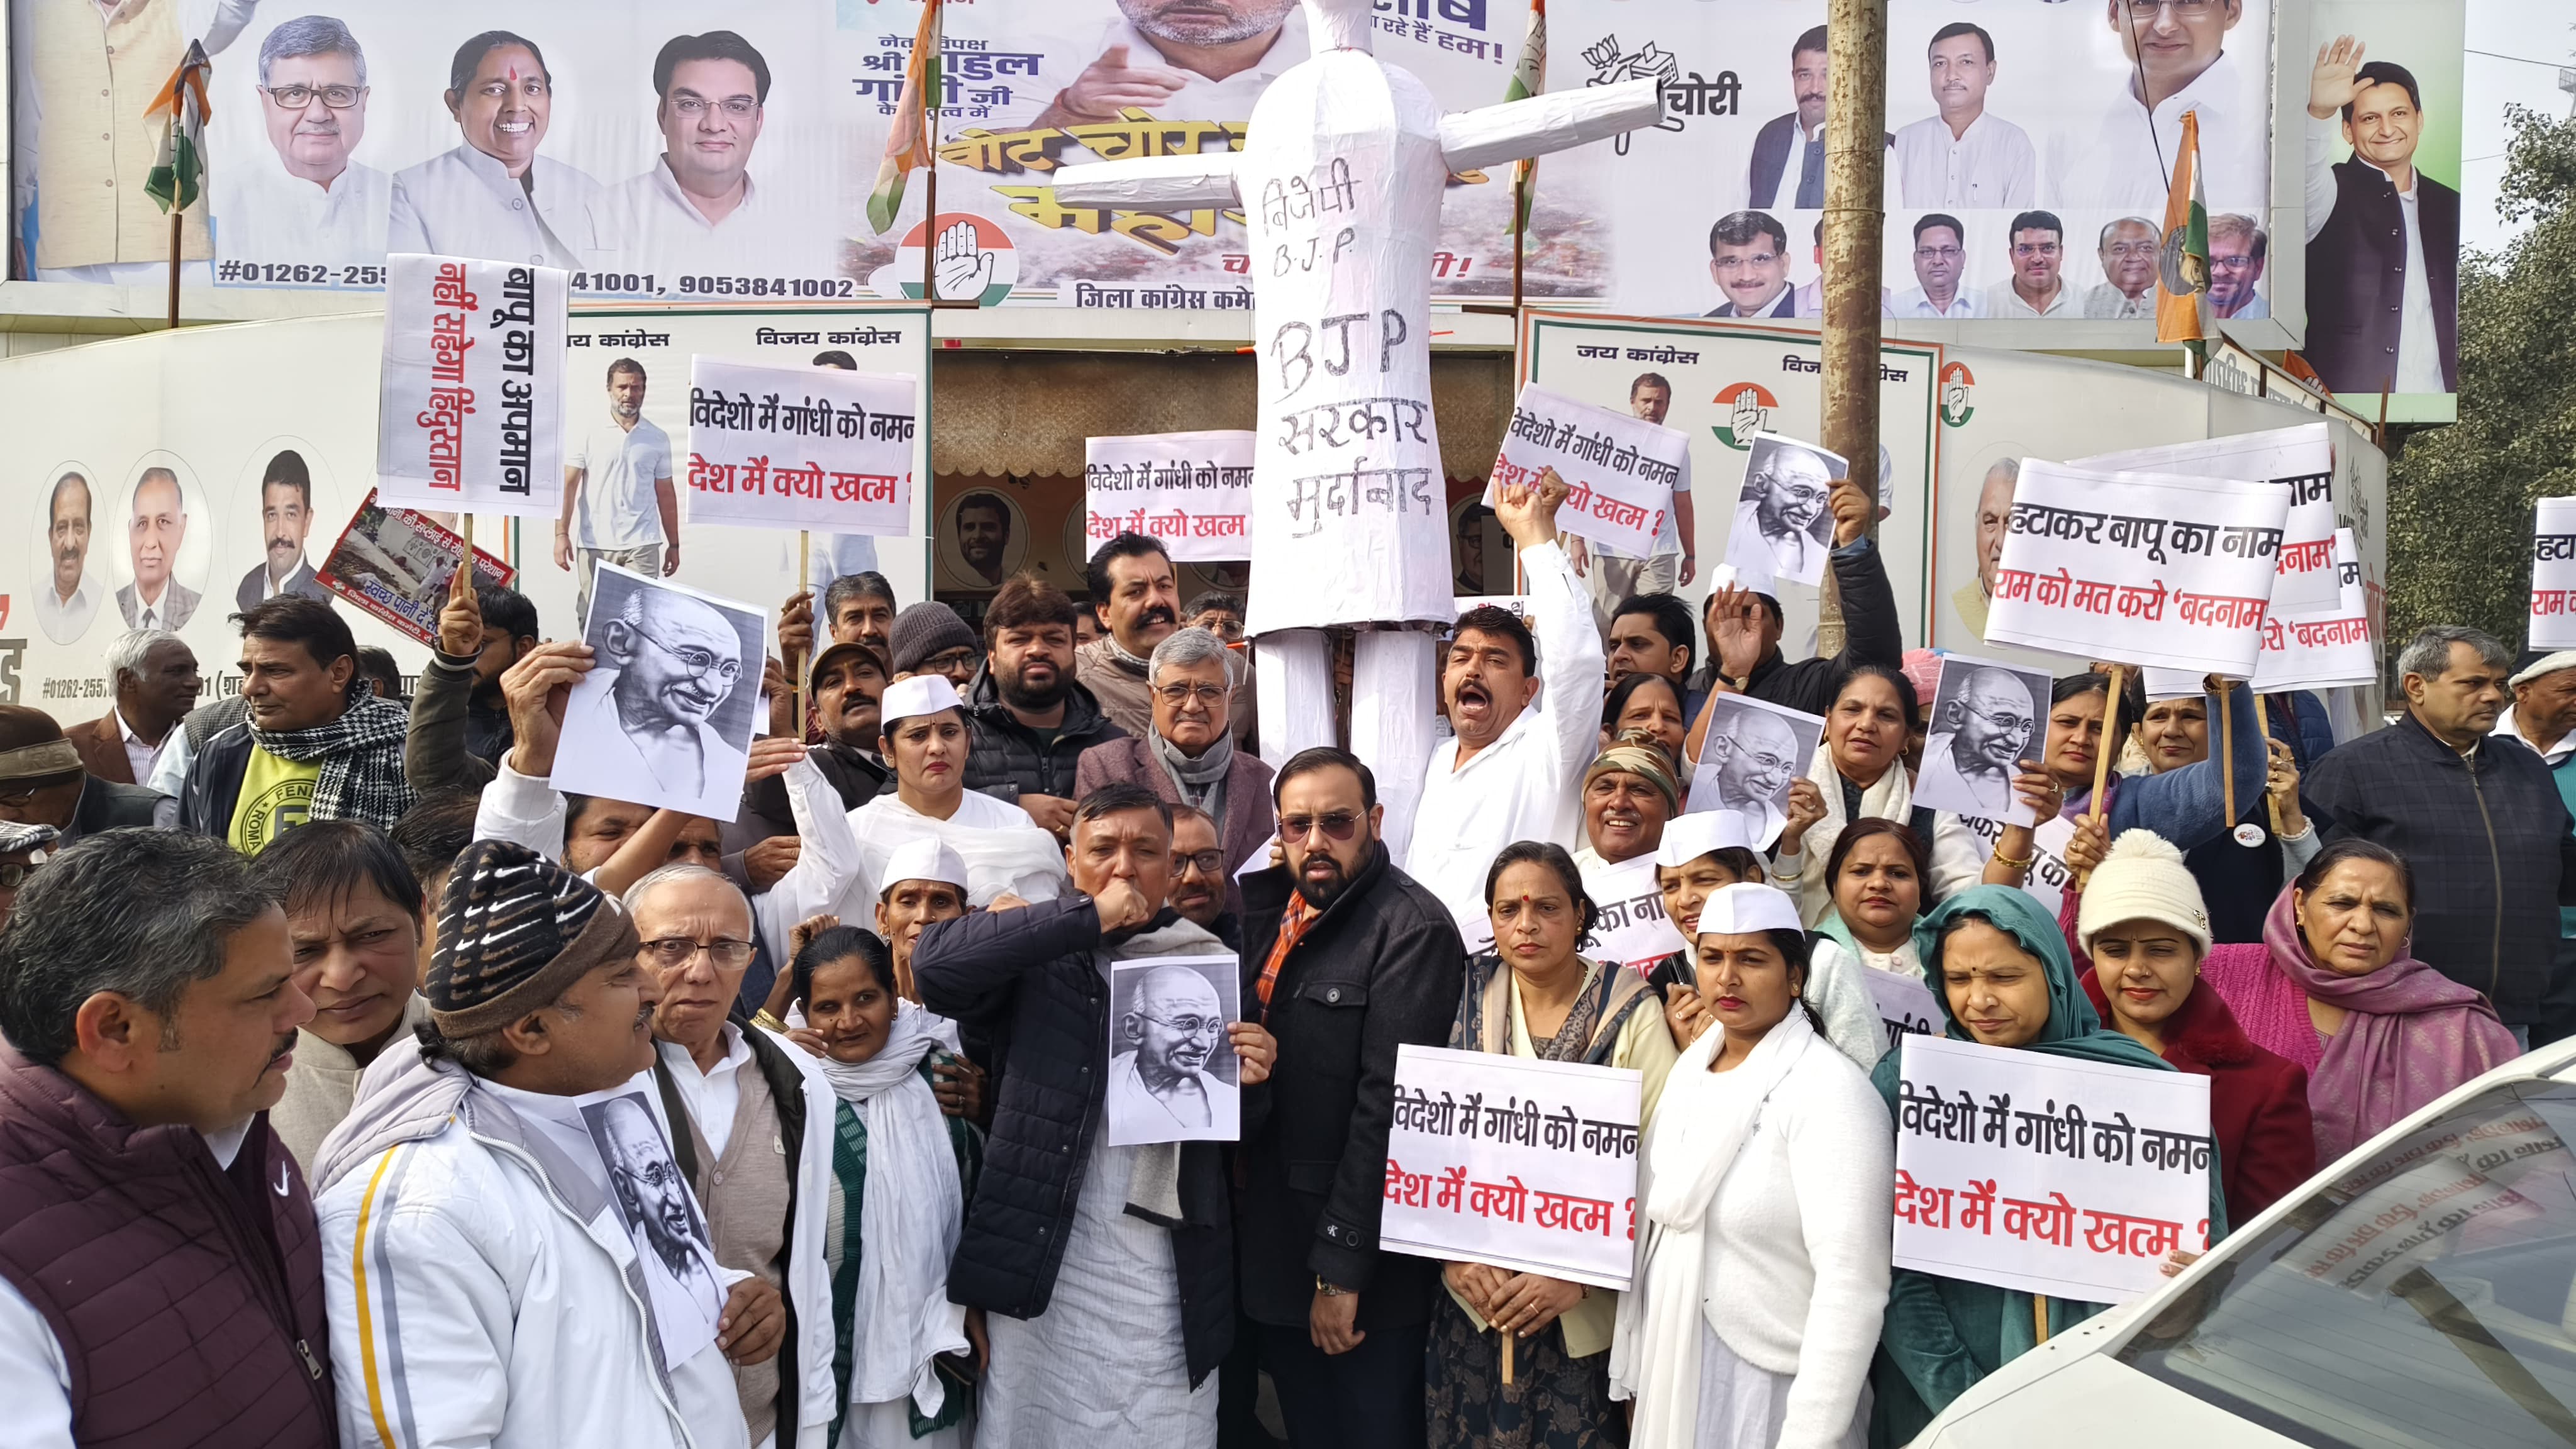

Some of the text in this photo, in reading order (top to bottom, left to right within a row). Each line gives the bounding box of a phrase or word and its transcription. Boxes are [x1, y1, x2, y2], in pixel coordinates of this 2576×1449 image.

[879, 34, 916, 48] नेत
[1382, 17, 1409, 36] रहे
[862, 51, 1044, 80] श्री ाहुल
[967, 86, 1013, 105] जी
[968, 105, 992, 118] में
[935, 127, 1064, 172] वोट
[219, 260, 386, 285] #01262-25
[679, 276, 853, 298] 9053841002
[1076, 283, 1256, 309] जिला कांग्रेस कमे
[598, 328, 670, 348] कांग्रेस
[756, 326, 902, 345] विजय कांग्रेस
[1576, 345, 1700, 364] जय कांग्रेस
[1782, 355, 1821, 374] विज
[416, 263, 479, 491] नहीं सहेगा हिंदुस्तान
[490, 268, 535, 496] बापू का अपमान
[689, 387, 755, 431] विदेशो
[758, 393, 780, 433] में
[782, 396, 833, 437] गांधी
[836, 402, 866, 440] को
[1278, 397, 1428, 455] सरकार
[1555, 424, 1577, 454] में
[1572, 431, 1614, 467] गांधी
[1612, 445, 1639, 476] को
[1638, 456, 1680, 490] नमन
[687, 452, 737, 494] देश
[741, 455, 769, 496] में
[773, 460, 826, 499] क्यो
[830, 471, 898, 504] खत्म
[1085, 463, 1134, 492] विदेशो
[1136, 460, 1152, 491] में
[1154, 459, 1192, 490] गांधी
[1195, 460, 1218, 489] को
[1085, 510, 1122, 538] देश
[1149, 508, 1189, 537] क्यो
[1192, 514, 1246, 537] खत्म
[1593, 493, 1649, 531] खत्म
[1651, 509, 1665, 537] ?
[2007, 501, 2284, 565] हटाकर बापू का नाम
[441, 533, 453, 548] से
[450, 541, 477, 565] रोहक
[478, 556, 506, 580] परेशान
[2535, 534, 2576, 561] हटा
[393, 596, 420, 619] पानी
[1992, 567, 2036, 602] राम
[2036, 567, 2073, 608] को
[2074, 579, 2116, 614] मत
[2117, 578, 2168, 621] करो
[2531, 589, 2567, 616] राम
[2260, 617, 2285, 651] रो
[247, 809, 265, 850] ROMA
[1629, 891, 1666, 921] ना
[1391, 1084, 1457, 1137] विदेशो
[1458, 1092, 1483, 1140] में
[1484, 1096, 1540, 1147] गांधी
[1543, 1106, 1578, 1152] को
[1899, 1080, 1979, 1145] विदेशो
[1982, 1093, 2011, 1149] में
[2014, 1098, 2087, 1160] गांधी
[2092, 1112, 2136, 1167] को
[1383, 1159, 1433, 1208] देश
[1436, 1165, 1468, 1214] में
[1470, 1175, 1528, 1223] क्यो
[1533, 1190, 1614, 1237] खत्म
[1894, 1169, 1955, 1230] देश
[1959, 1178, 1997, 1236] में
[2002, 1192, 2077, 1248] क्यो
[2082, 1208, 2184, 1258] खत्म
